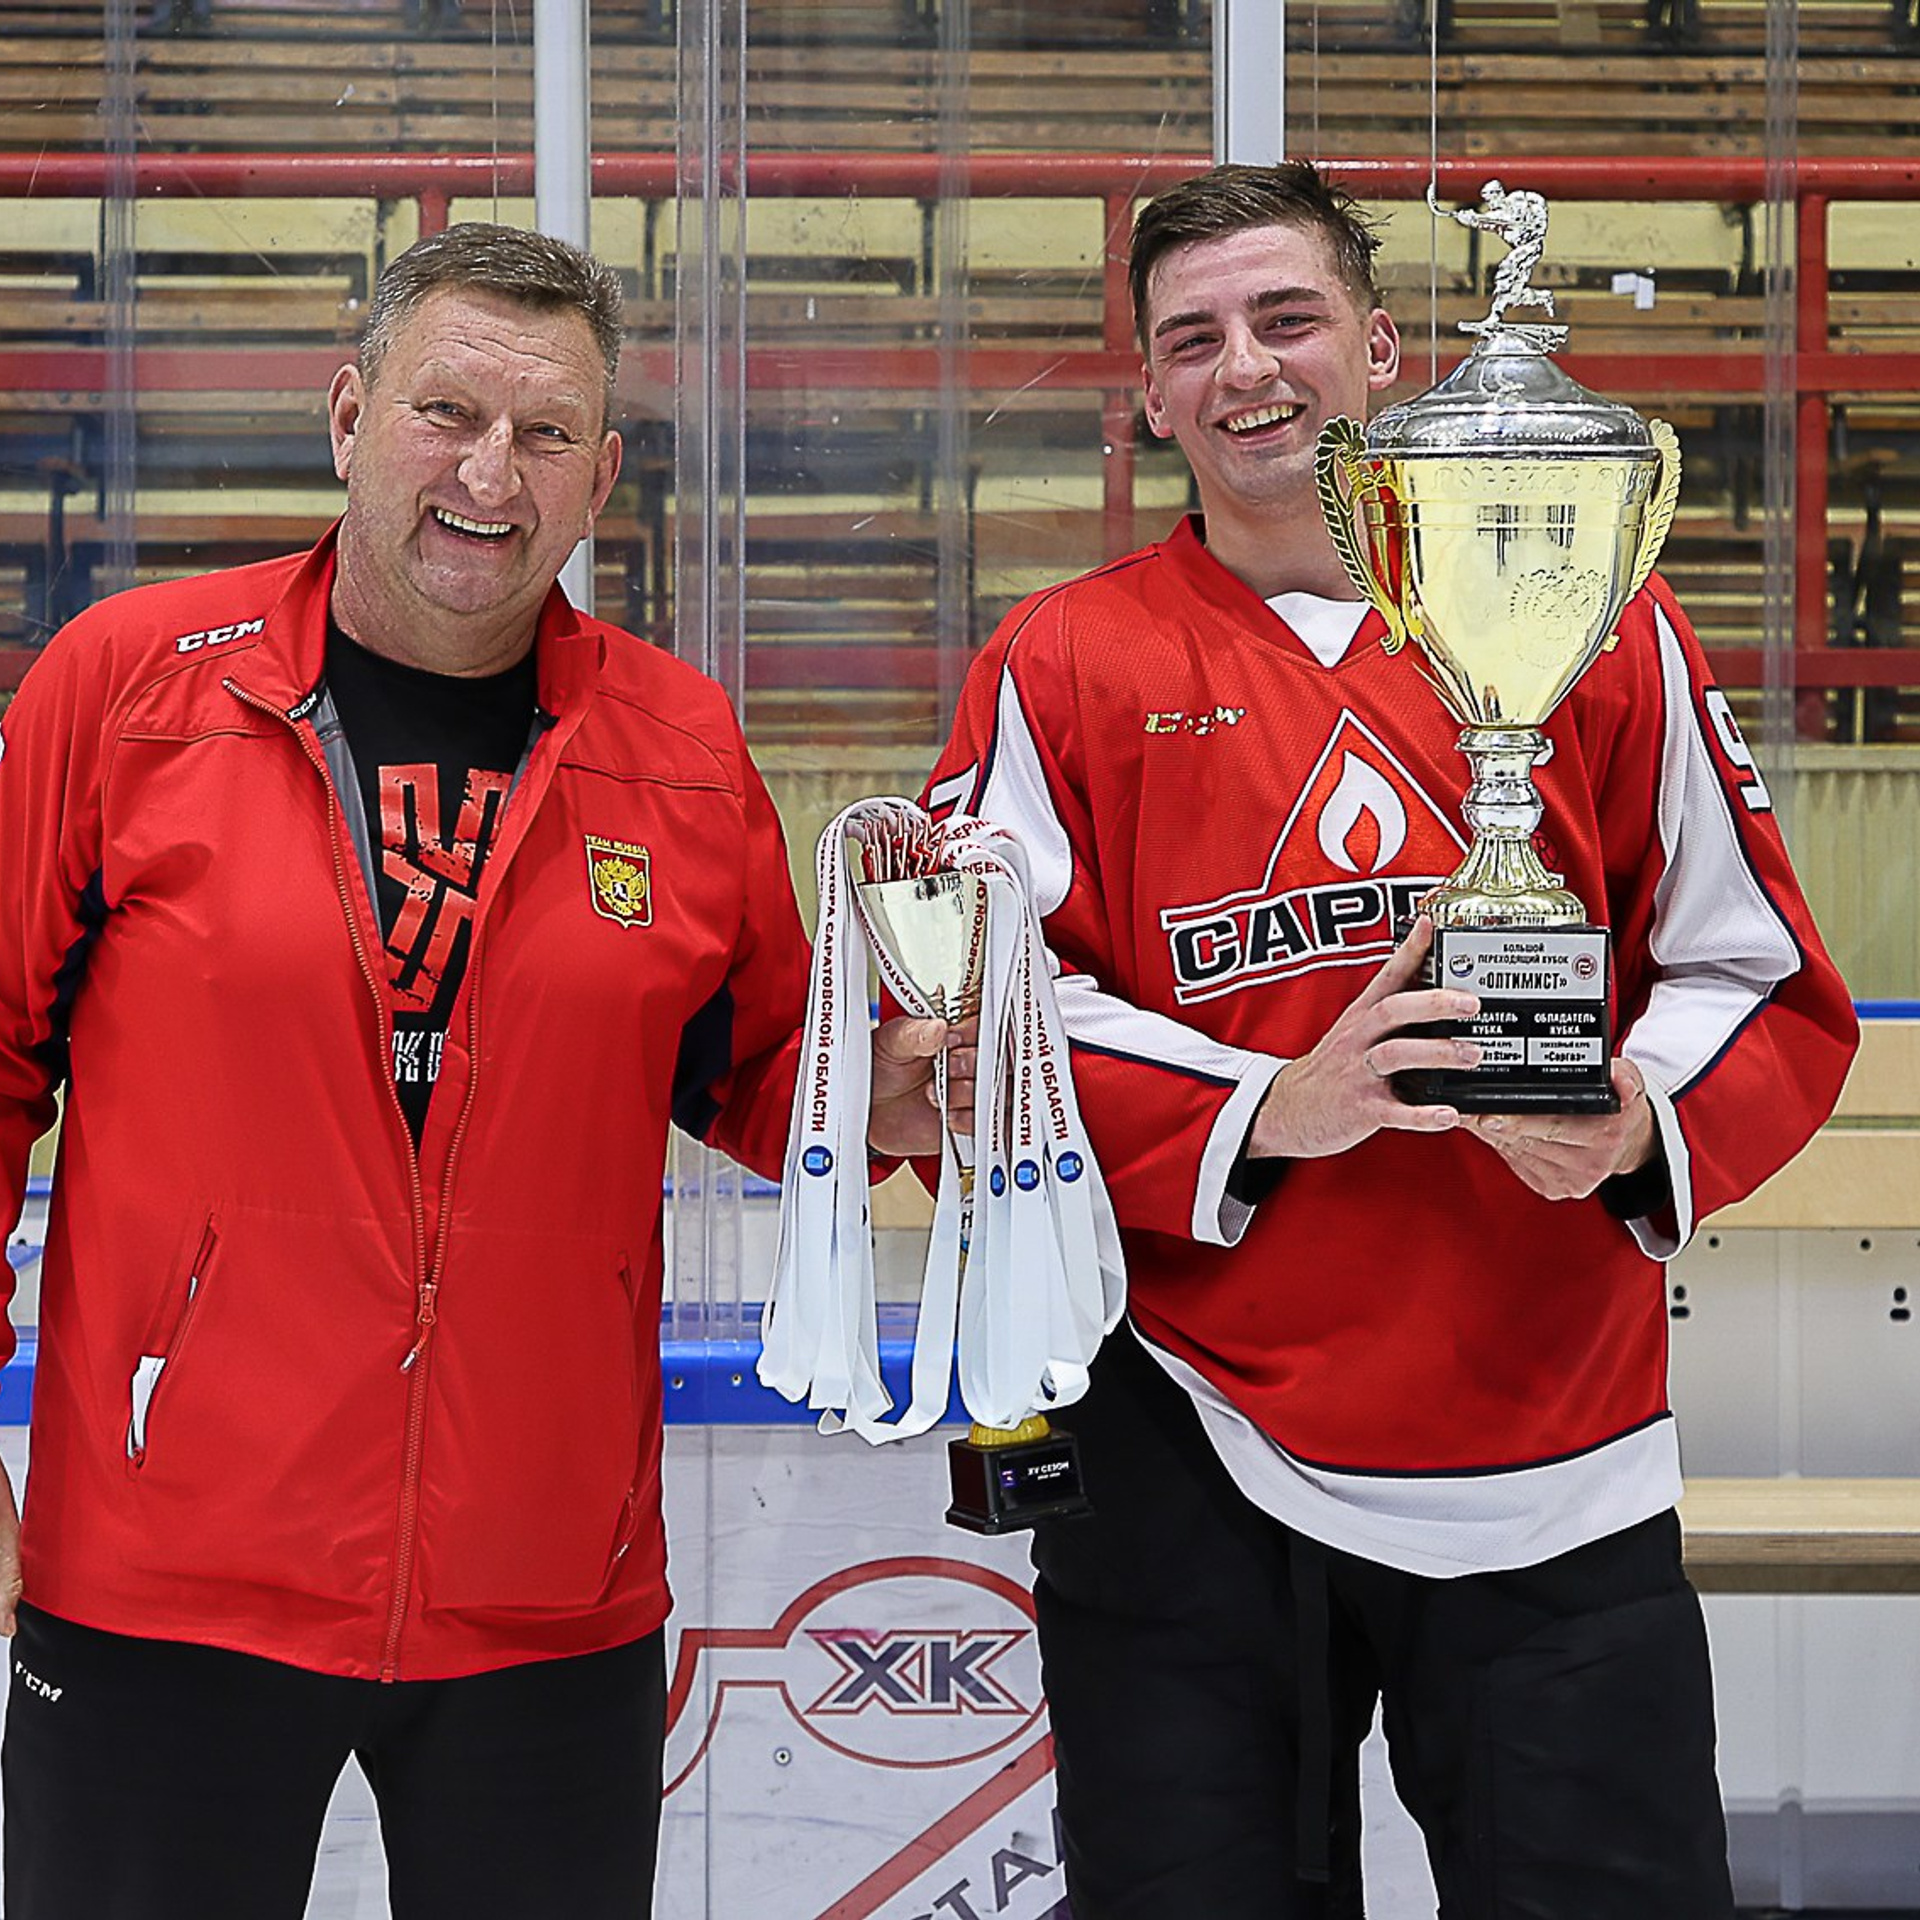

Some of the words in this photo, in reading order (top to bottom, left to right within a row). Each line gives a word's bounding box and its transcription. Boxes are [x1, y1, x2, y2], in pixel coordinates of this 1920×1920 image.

[176, 618, 265, 653] CCM
[288, 692, 317, 720] CCM
[1477, 953, 1541, 965] ПЕРЕХОДЯЩИЙ
[1542, 954, 1570, 964] КУБОК
[1503, 942, 1546, 953] БОЛЬШОЙ
[818, 921, 835, 1048] САРАТОВСКОЙ
[1478, 971, 1568, 990] «ОПТИМИСТ»
[1533, 1012, 1597, 1023] ОБЛАДАТЕЛЬ
[1471, 1025, 1503, 1035] КУБКА
[1549, 1025, 1581, 1035] КУБКА
[811, 1052, 830, 1133] ОБЛАСТИ
[1040, 1060, 1070, 1141] ОБЛАСТИ
[1020, 1068, 1032, 1147] ОБЛАСТИ
